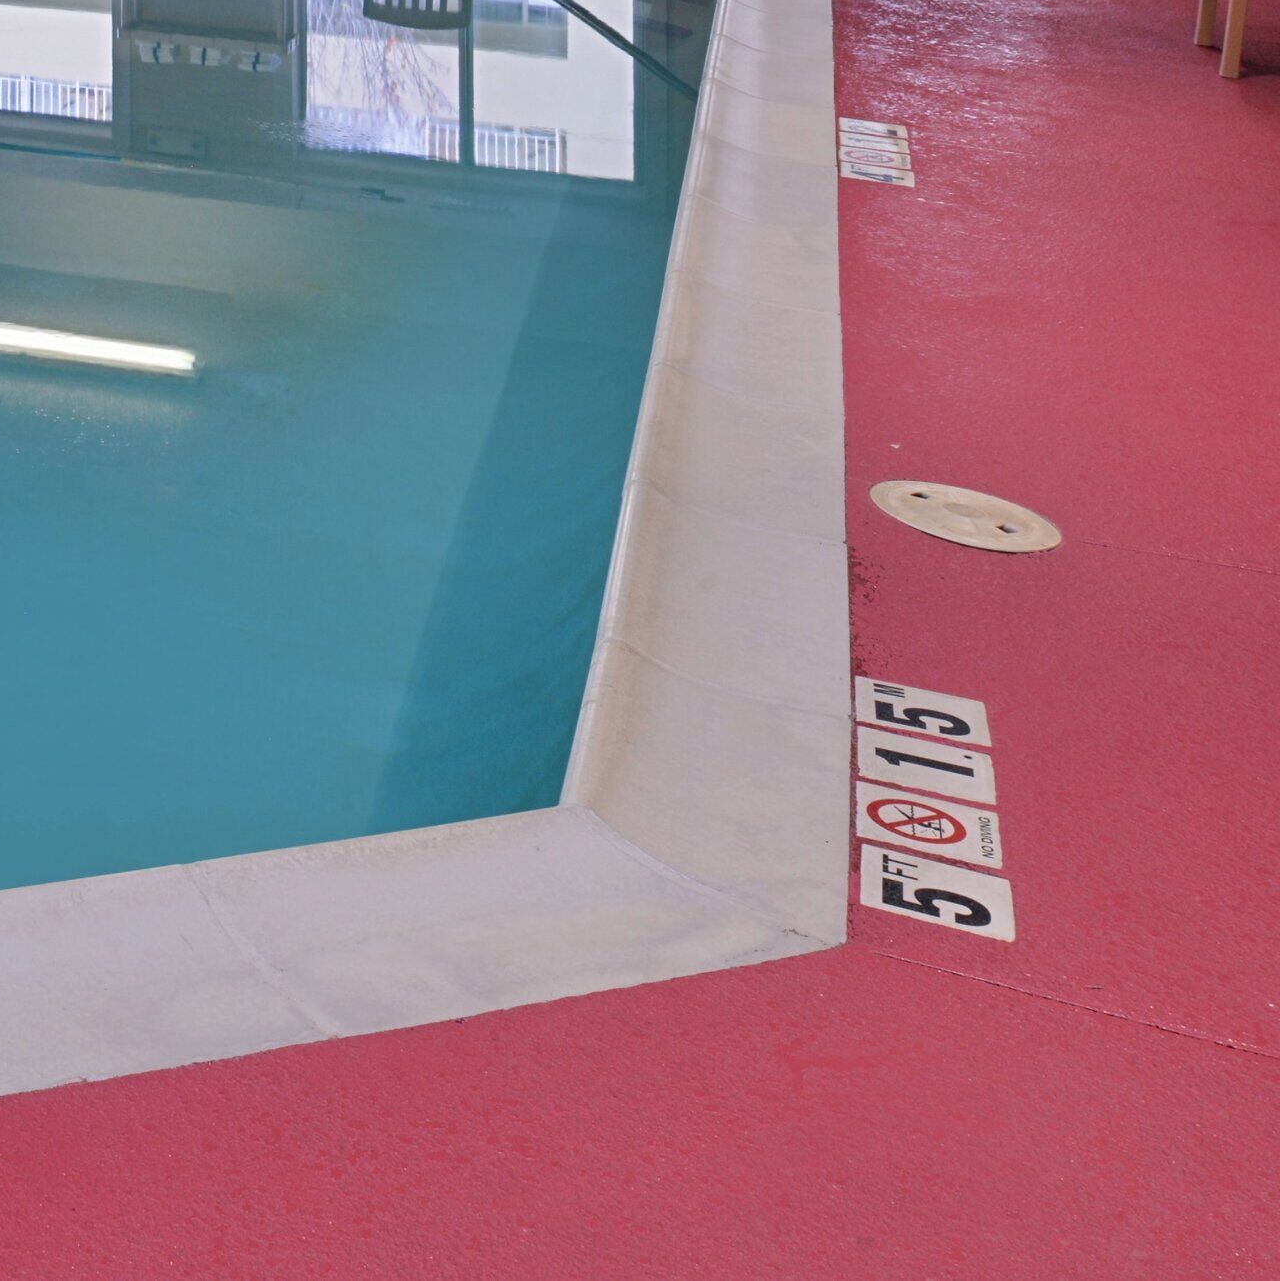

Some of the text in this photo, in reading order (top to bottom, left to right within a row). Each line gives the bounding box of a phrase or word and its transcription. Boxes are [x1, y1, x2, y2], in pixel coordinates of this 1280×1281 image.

[873, 682, 971, 737] 5 M
[978, 816, 995, 860] NO DIVING
[882, 854, 992, 927] 5 FT
